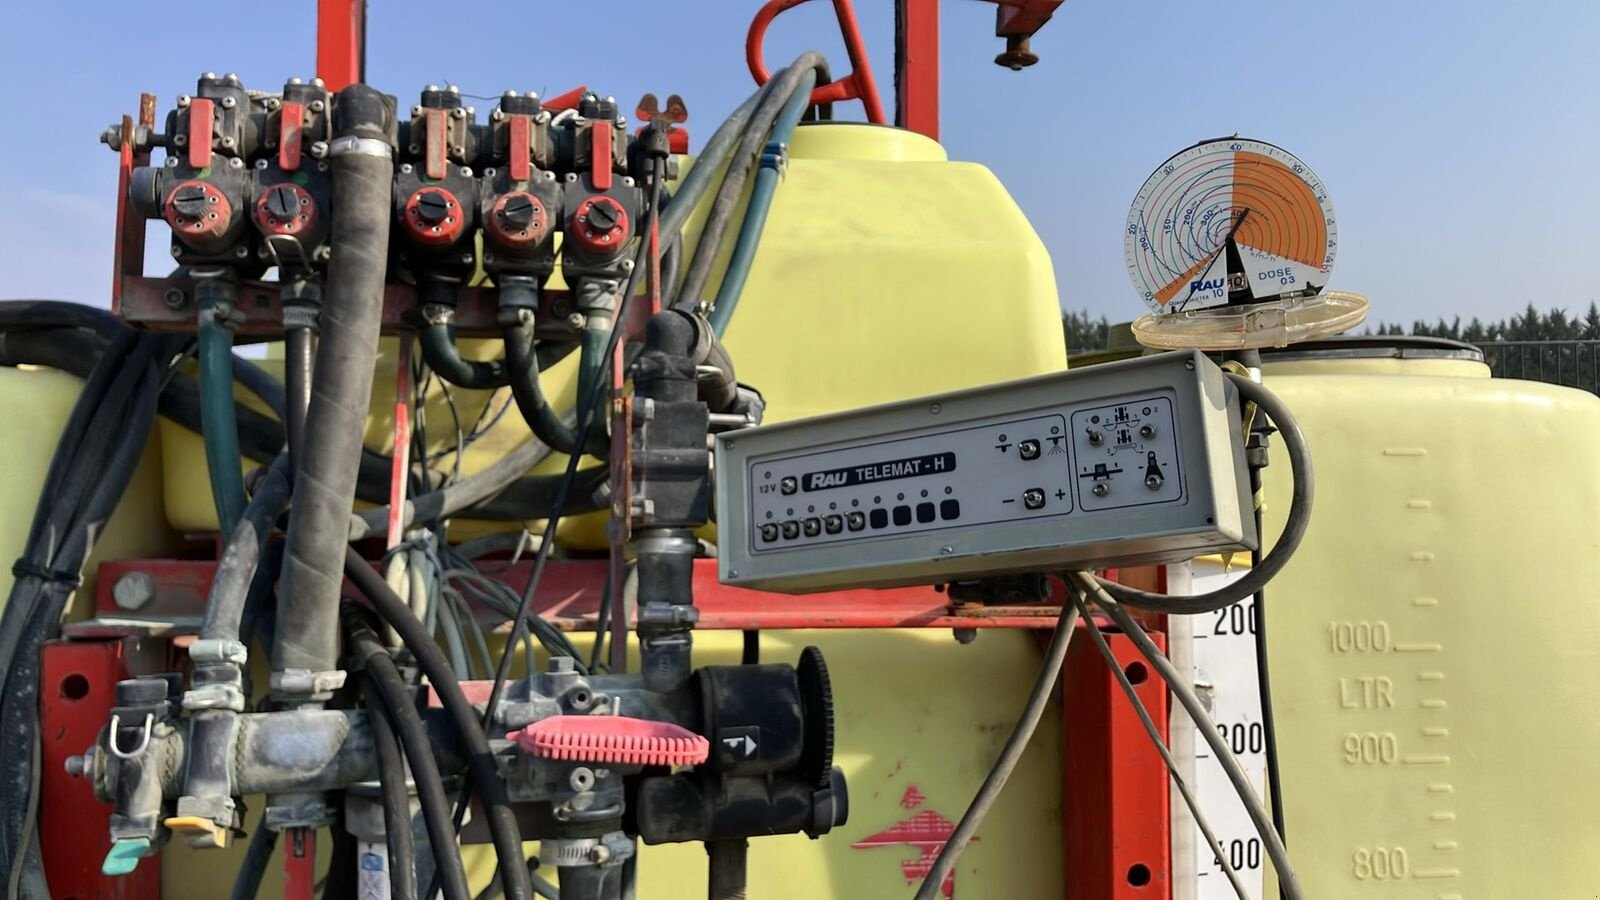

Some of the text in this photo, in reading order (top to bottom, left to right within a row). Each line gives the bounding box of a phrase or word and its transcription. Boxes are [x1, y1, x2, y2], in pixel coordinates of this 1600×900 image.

[1190, 277, 1225, 293] RAU
[1212, 288, 1224, 299] 10
[1280, 275, 1296, 286] 03
[810, 472, 848, 489] RAU
[1213, 603, 1256, 636] 200
[1326, 619, 1390, 654] 1000
[1338, 676, 1395, 709] LTR
[1343, 731, 1398, 765] 900
[1351, 846, 1408, 881] 800
